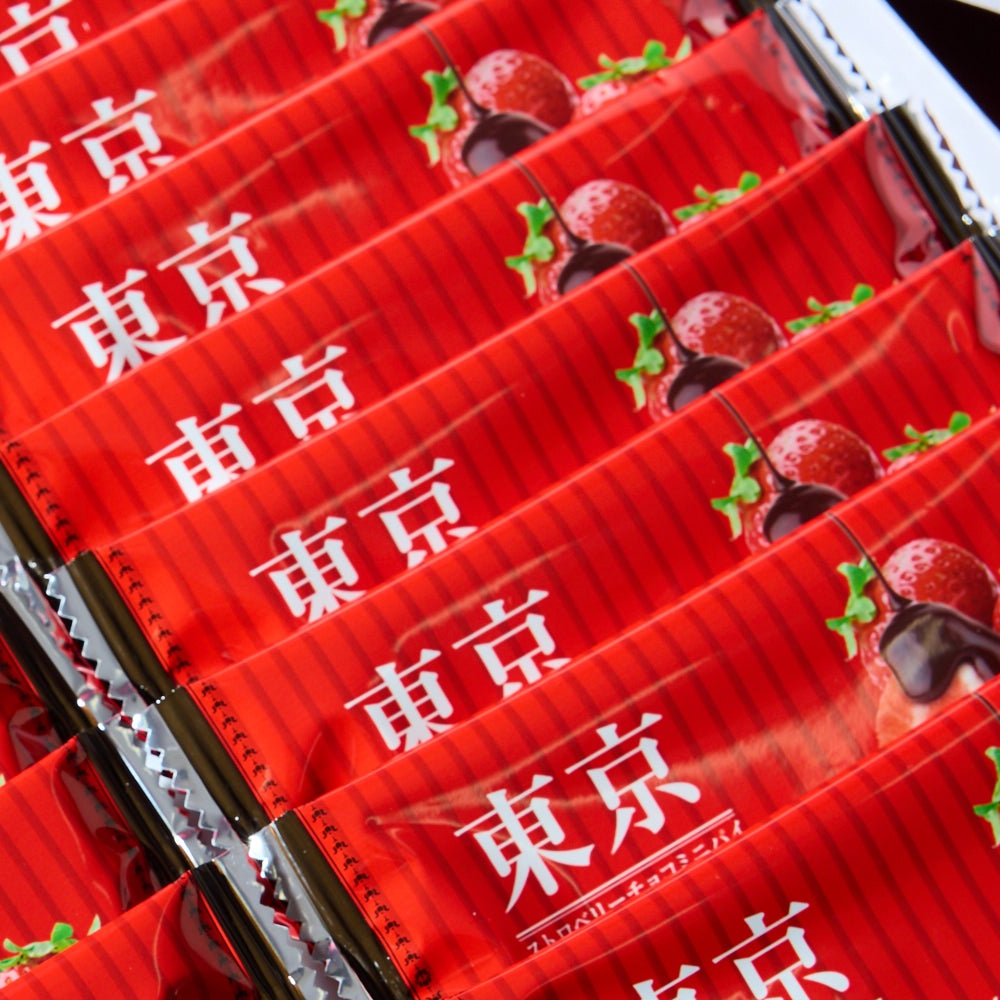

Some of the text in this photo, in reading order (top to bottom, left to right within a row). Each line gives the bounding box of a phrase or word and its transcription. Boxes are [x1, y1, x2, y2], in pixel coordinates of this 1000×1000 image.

[51, 213, 285, 383] 東京
[145, 346, 356, 503] 東京
[250, 458, 479, 623] 東京
[343, 589, 571, 752] 東京
[454, 713, 700, 913] 東京
